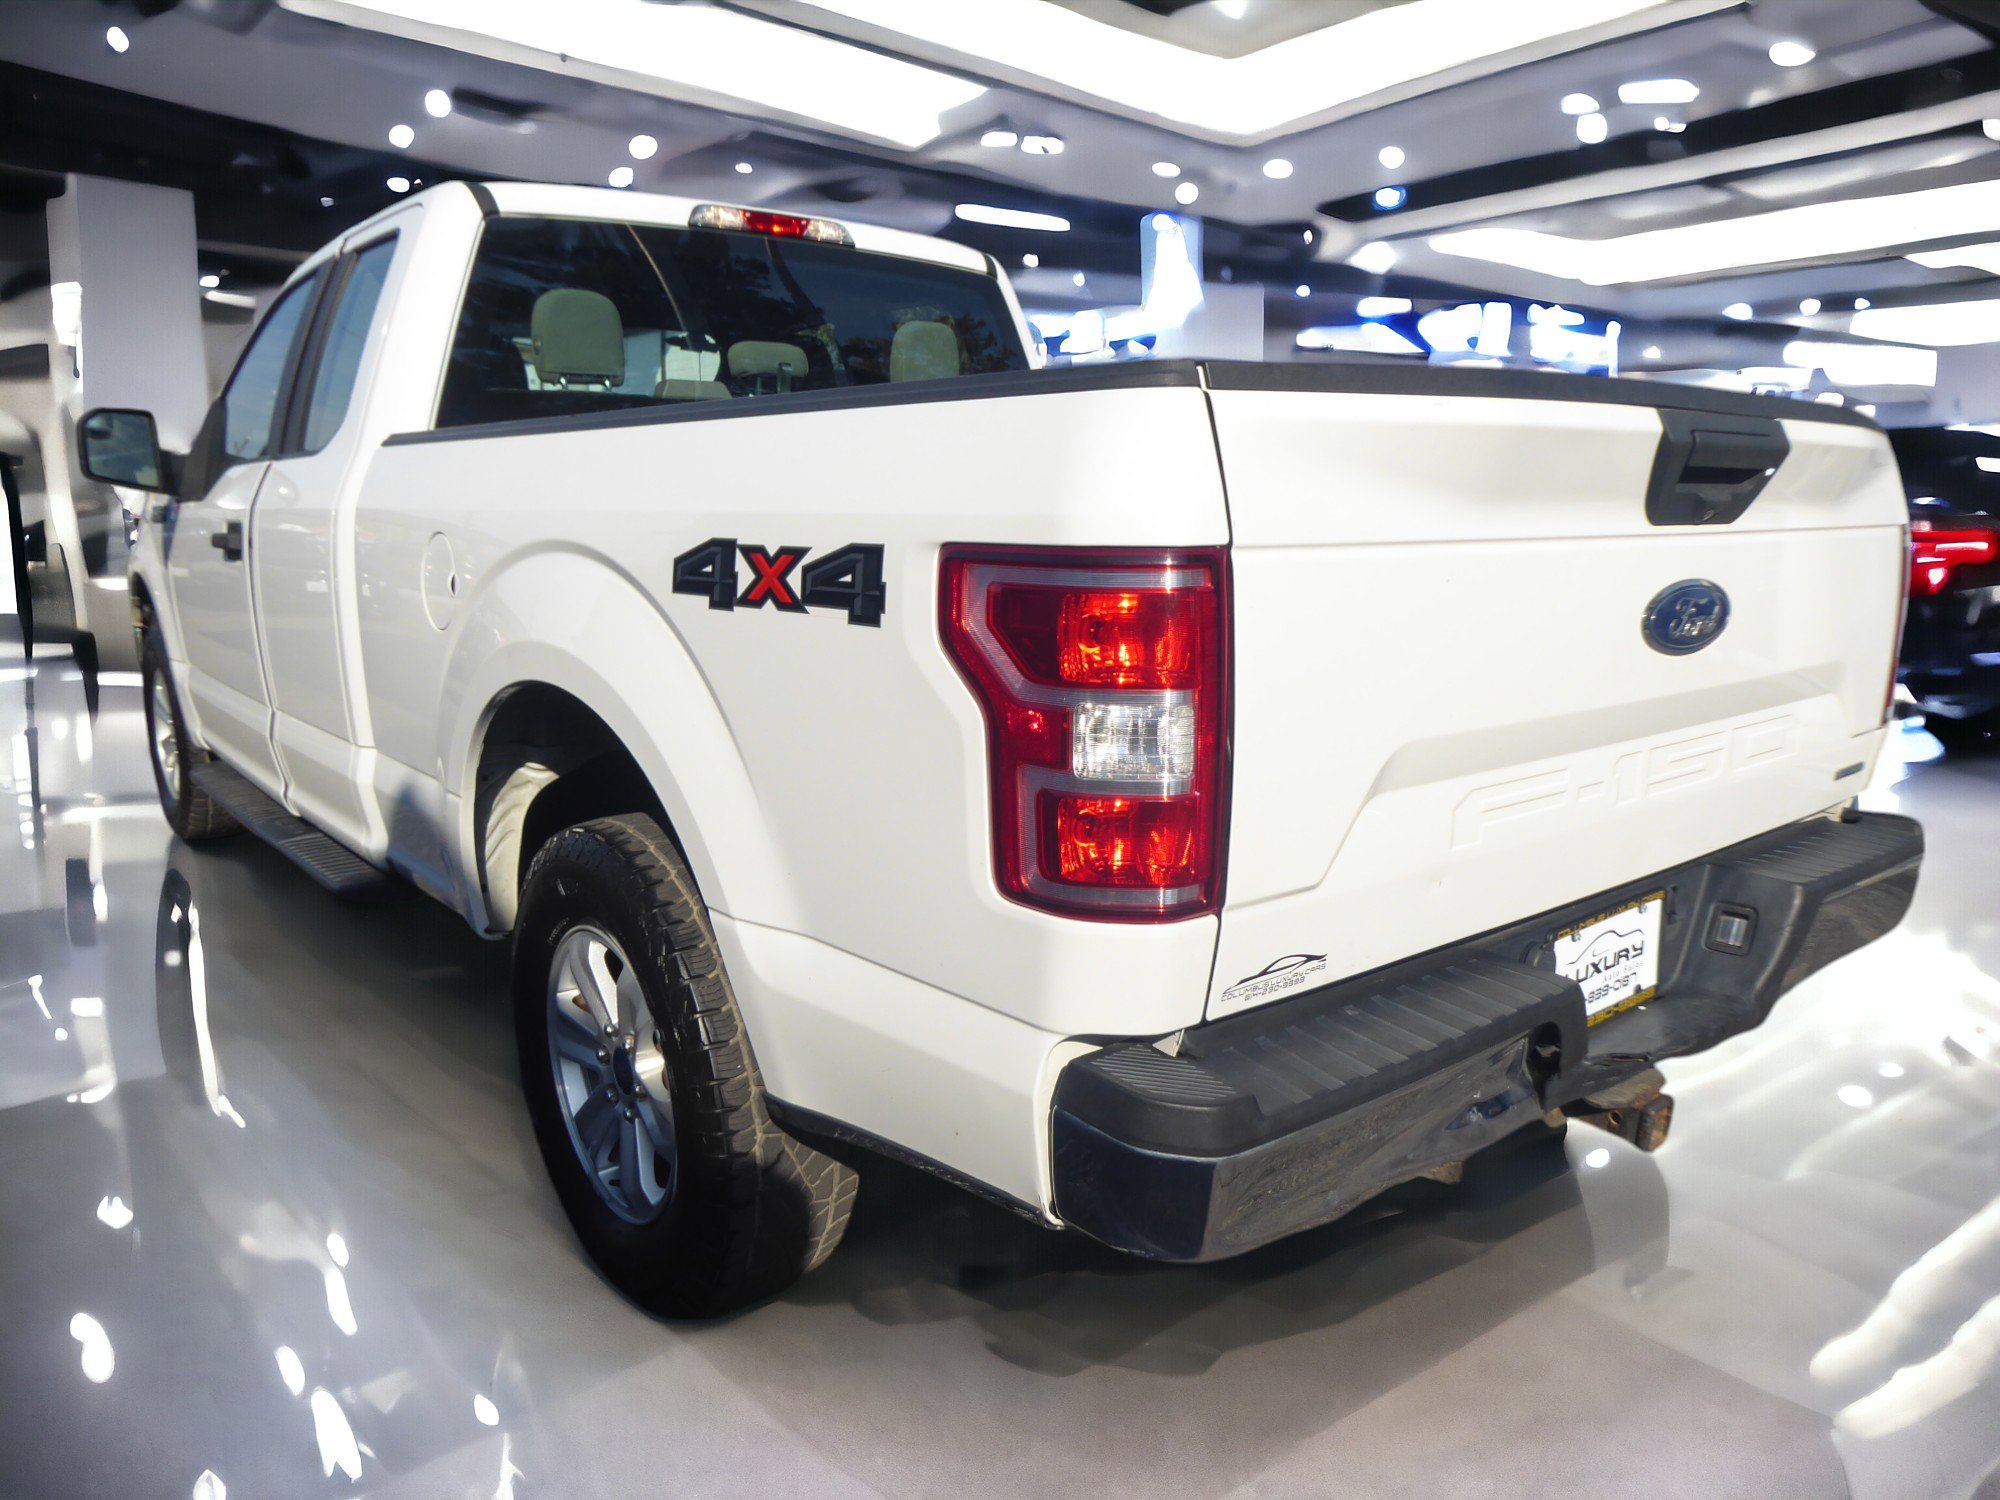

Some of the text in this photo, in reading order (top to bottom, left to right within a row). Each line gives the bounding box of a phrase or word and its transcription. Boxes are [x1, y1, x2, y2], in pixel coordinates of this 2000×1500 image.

[1669, 597, 1720, 637] Ford
[1451, 713, 1797, 851] F-150
[1221, 962, 1327, 1002] COLUMBUS LUXURY CARS
[1564, 939, 1645, 983] UXURY
